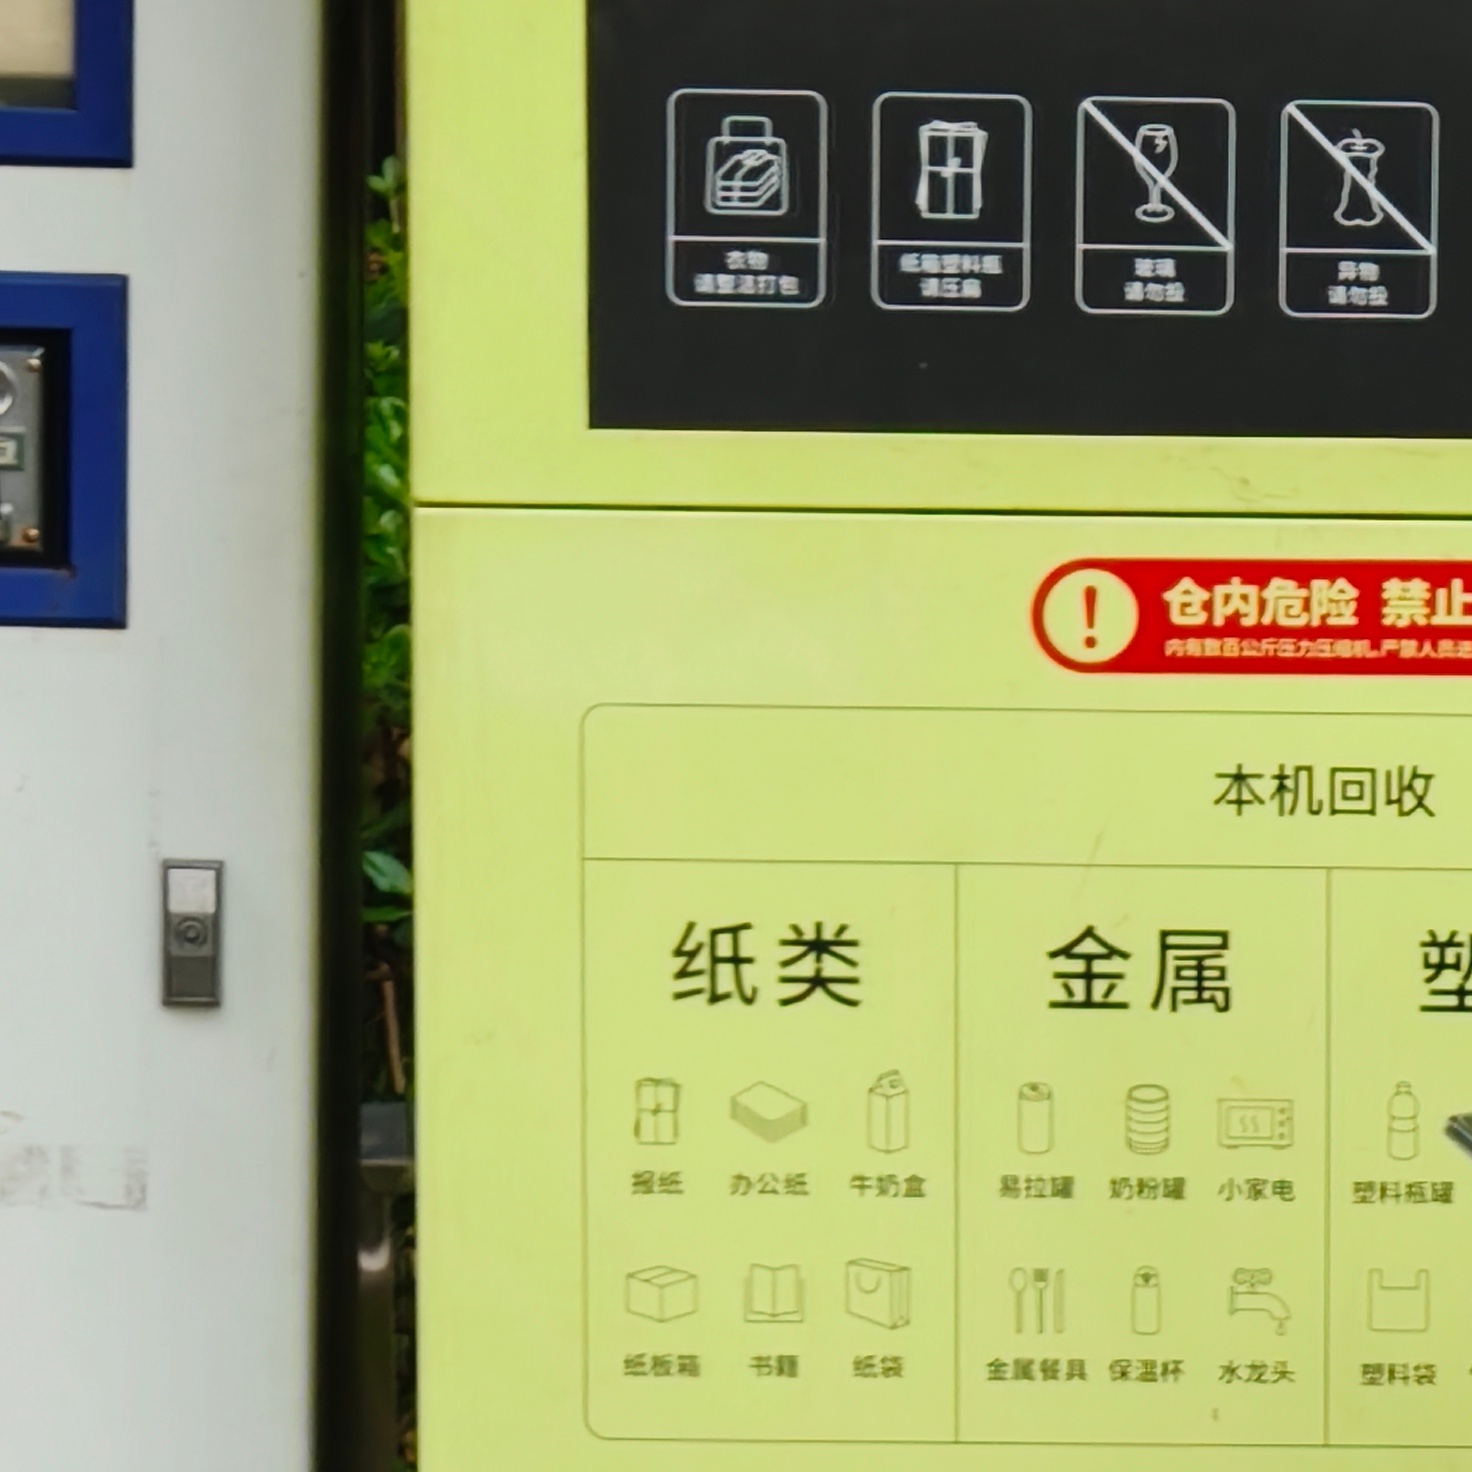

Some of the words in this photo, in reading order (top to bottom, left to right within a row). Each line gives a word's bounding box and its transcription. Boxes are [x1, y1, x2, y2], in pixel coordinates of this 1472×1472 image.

[1162, 577, 1359, 627] 仓内危险
[1214, 764, 1435, 817] 本机回收
[673, 922, 860, 1007] 纸类
[1048, 926, 1230, 1013] 金属
[632, 1171, 683, 1194] 报纸
[731, 1173, 809, 1196] 办公纸
[851, 1174, 926, 1198] 牛奶盒
[1000, 1175, 1074, 1199] 易拉罐
[1110, 1177, 1185, 1200] 奶粉罐
[1218, 1178, 1295, 1202] 小家电
[1353, 1181, 1453, 1204] 塑料瓶罐
[624, 1353, 700, 1377] 纸板箱
[750, 1355, 798, 1378] 书籍
[853, 1355, 903, 1378] 纸袋
[987, 1358, 1086, 1381] 金属餐具
[1109, 1359, 1183, 1382] 保温杯
[1219, 1361, 1294, 1384] 水龙头
[1362, 1363, 1436, 1386] 塑料袋
